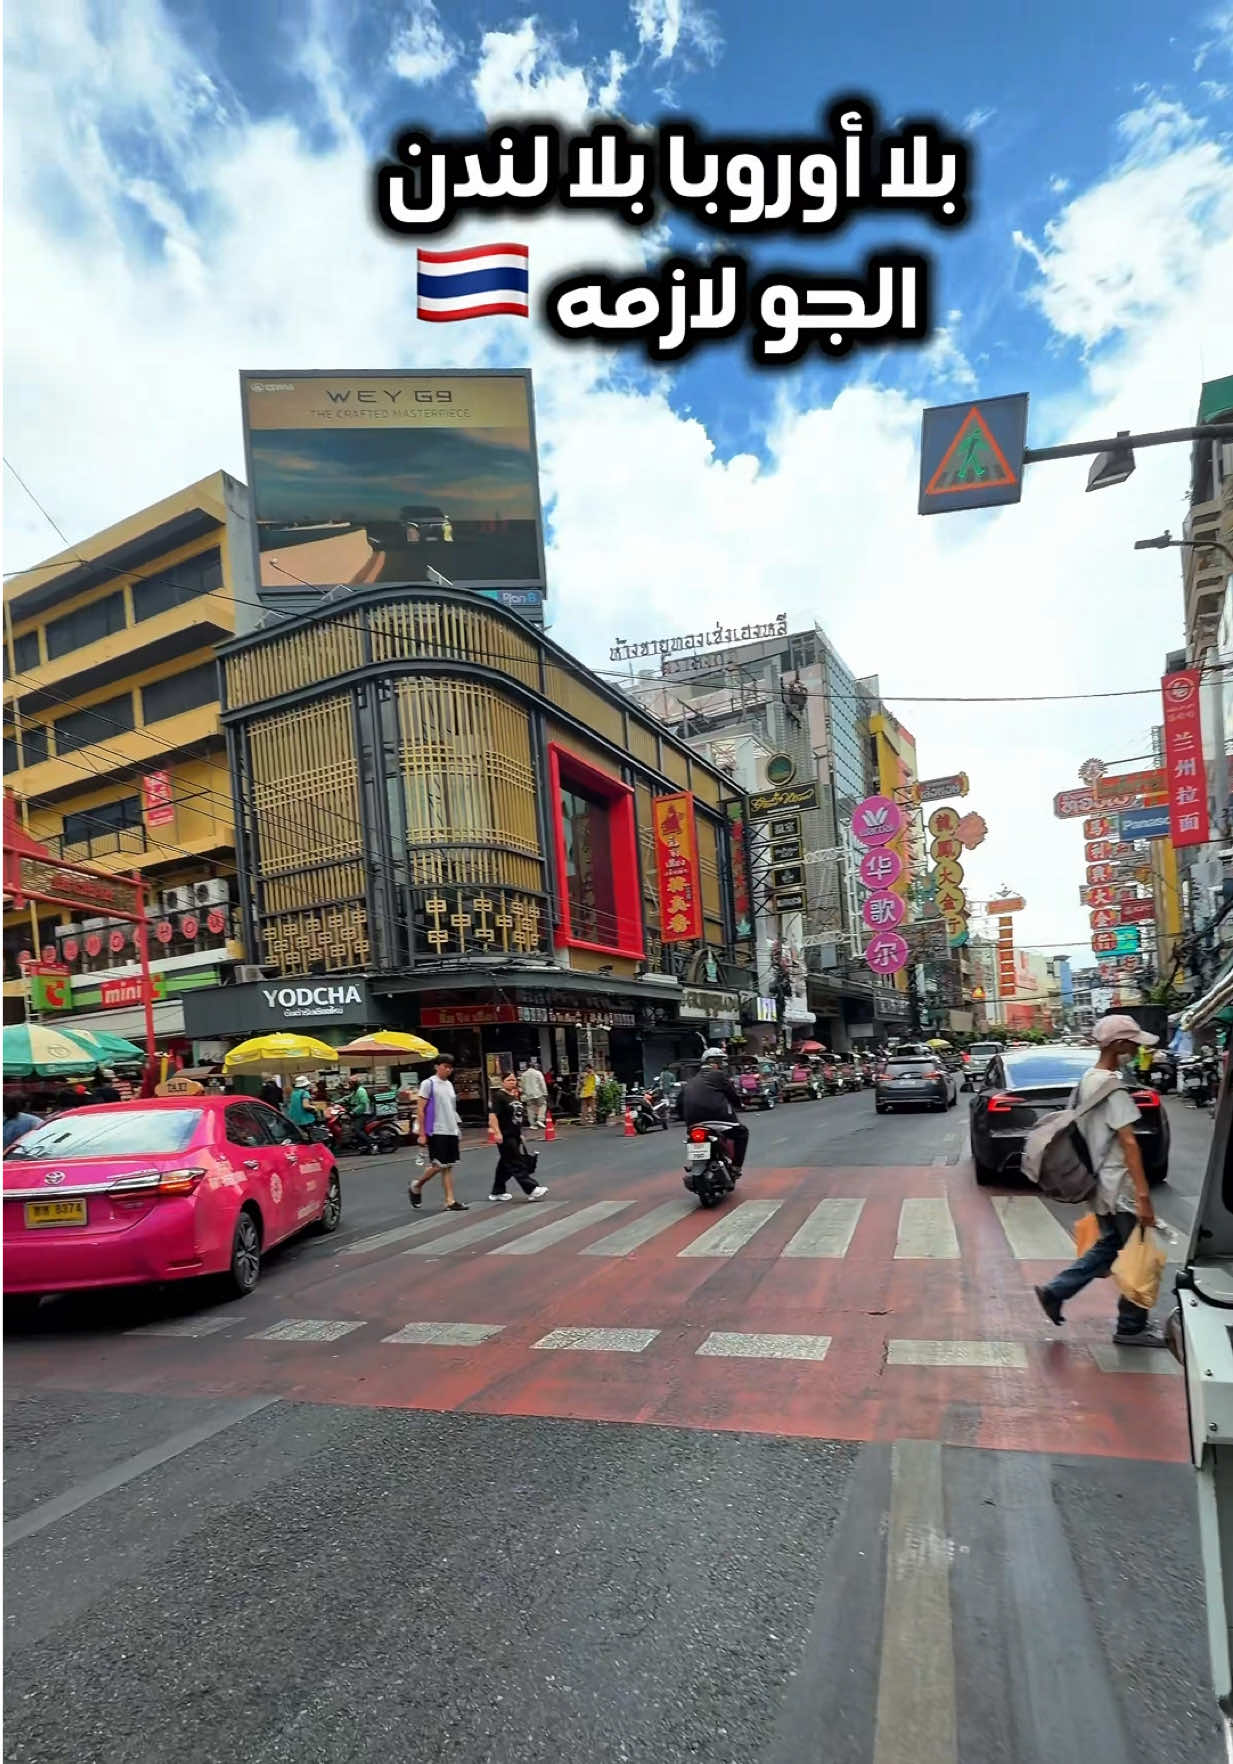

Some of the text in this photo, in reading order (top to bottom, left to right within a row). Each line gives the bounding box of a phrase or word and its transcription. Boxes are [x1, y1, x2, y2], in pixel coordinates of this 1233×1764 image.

[326, 389, 453, 404] WEY G9
[311, 409, 333, 419] THE
[336, 408, 389, 419] CRAFTED
[1173, 731, 1201, 833] 兰州拉面
[866, 856, 899, 968] 华歌尔
[105, 980, 142, 1004] mini
[262, 985, 362, 1008] YODCHA
